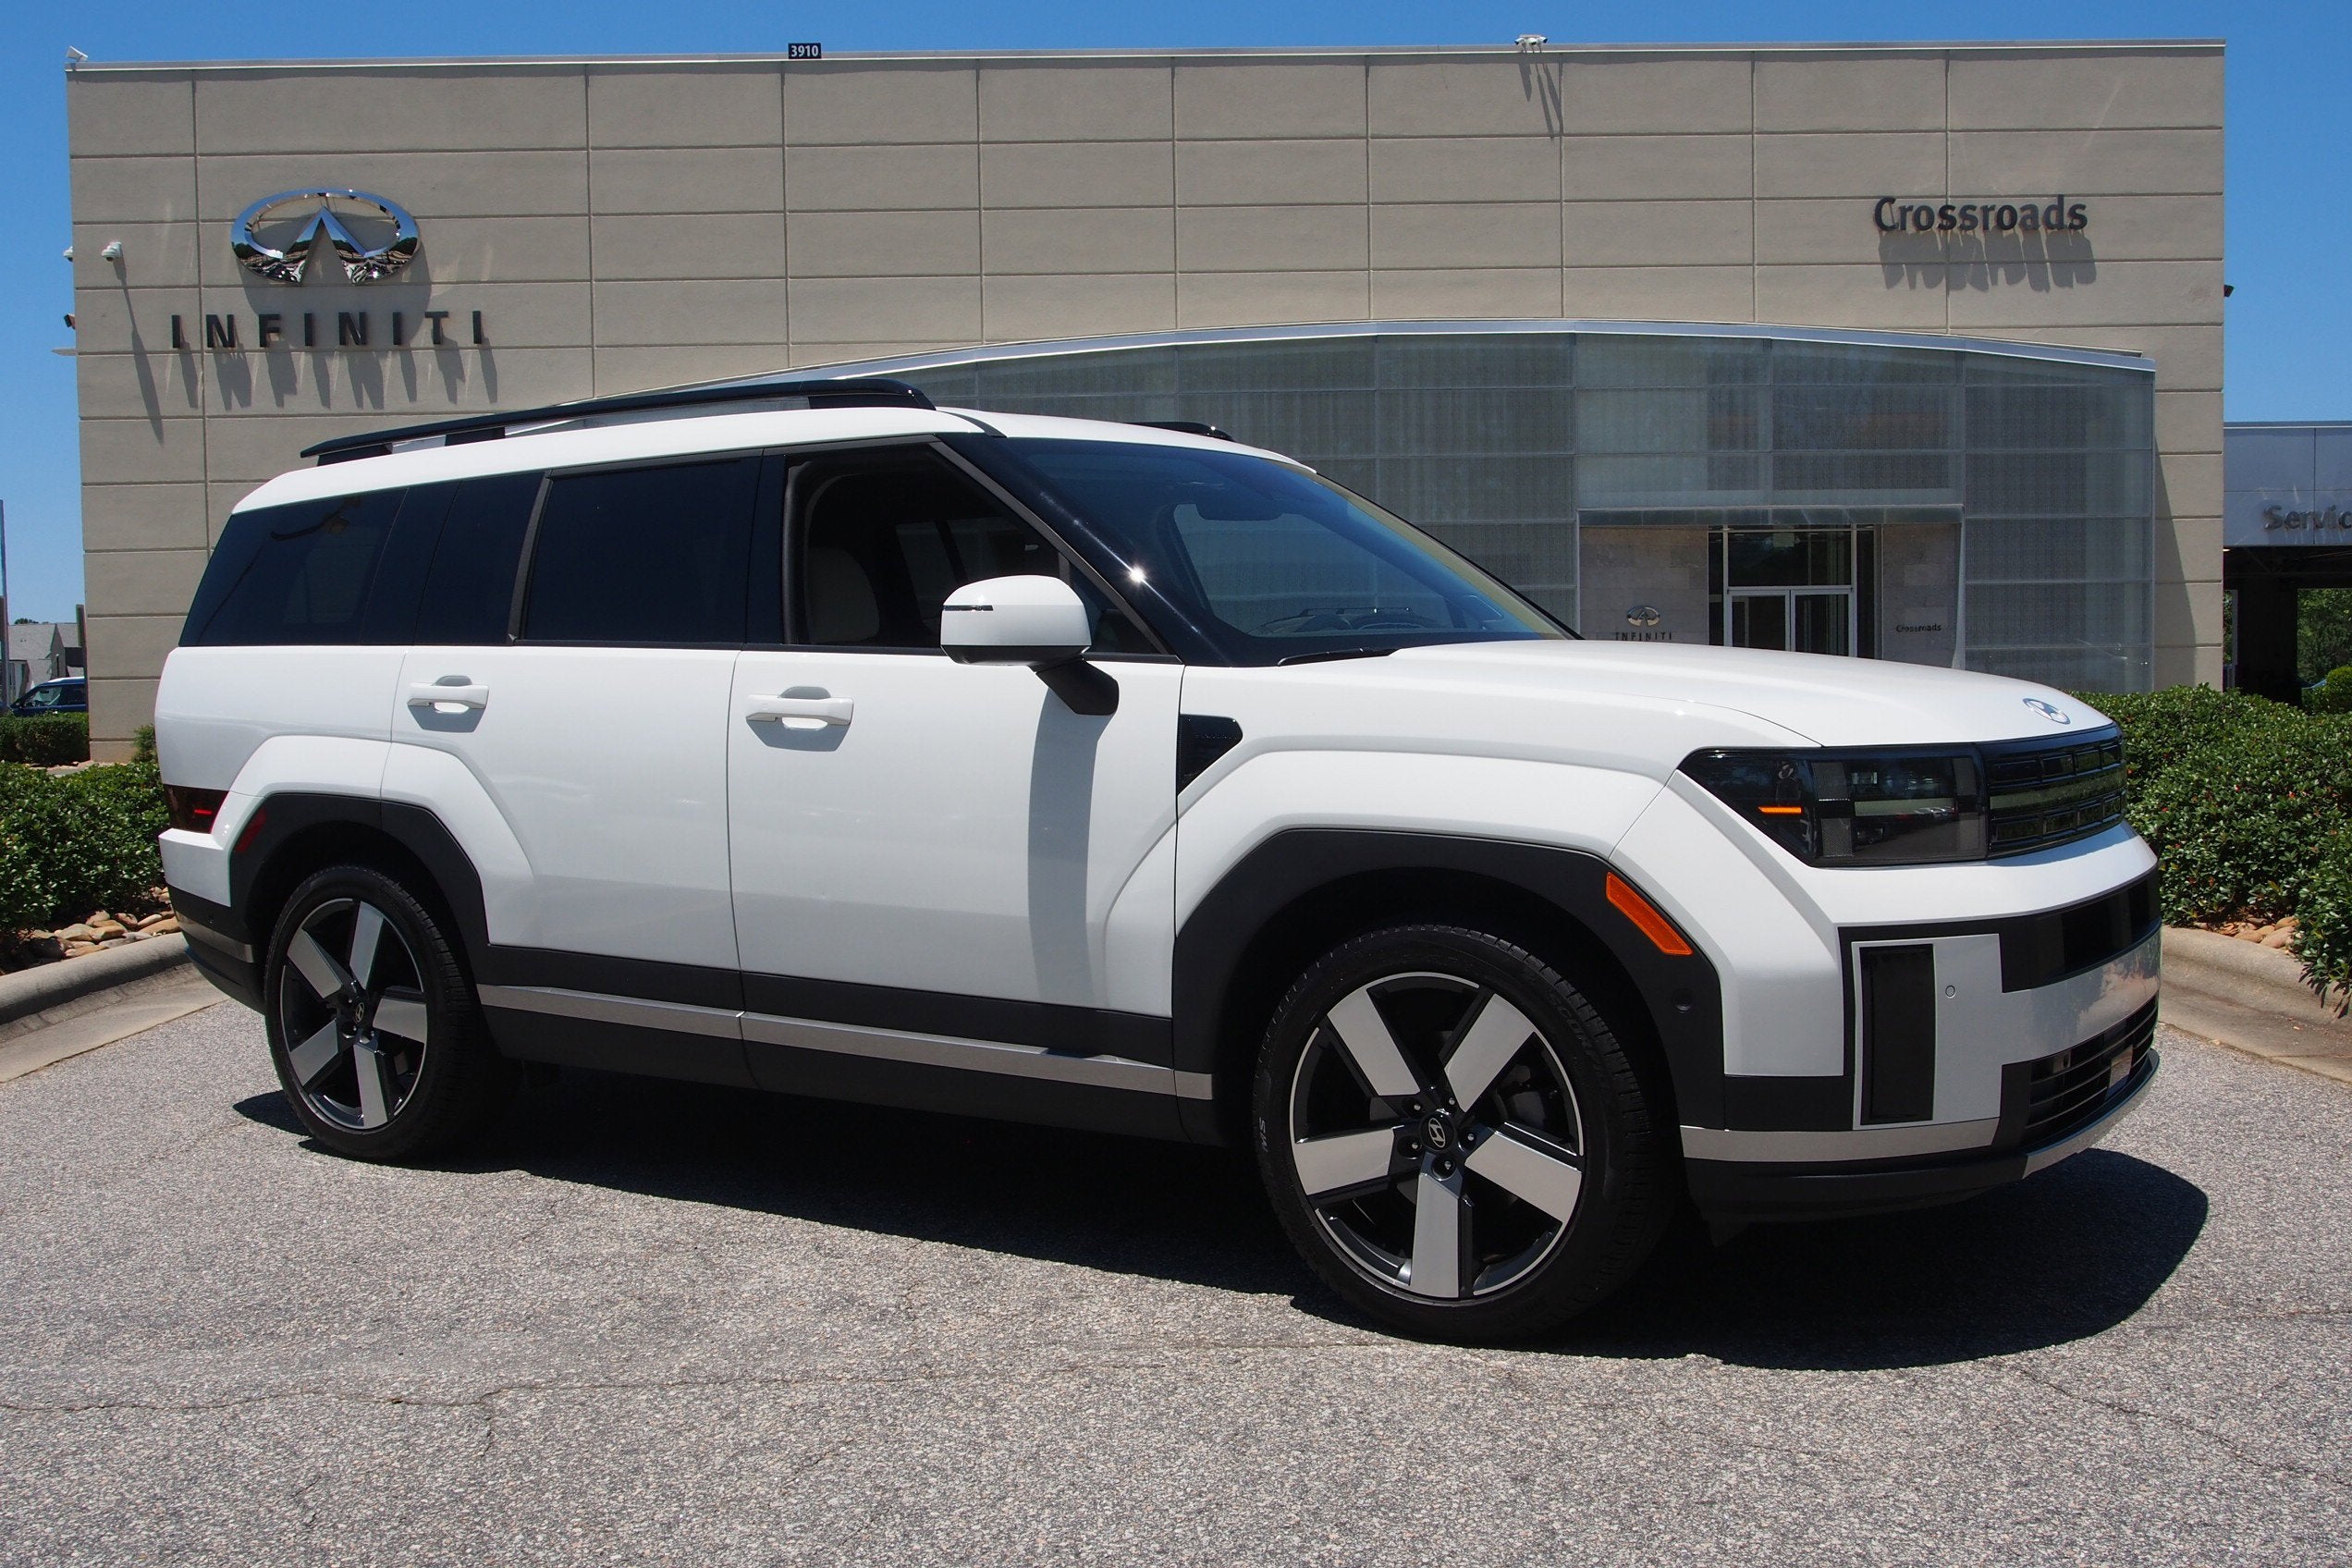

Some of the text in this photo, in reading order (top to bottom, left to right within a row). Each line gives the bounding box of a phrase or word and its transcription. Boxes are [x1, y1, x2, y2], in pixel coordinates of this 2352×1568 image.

[790, 44, 819, 57] 3910
[1874, 194, 2089, 231] Crossroads
[171, 310, 483, 349] INFINITI
[1895, 623, 1942, 633] Crossroads
[1614, 631, 1672, 642] INFINITI
